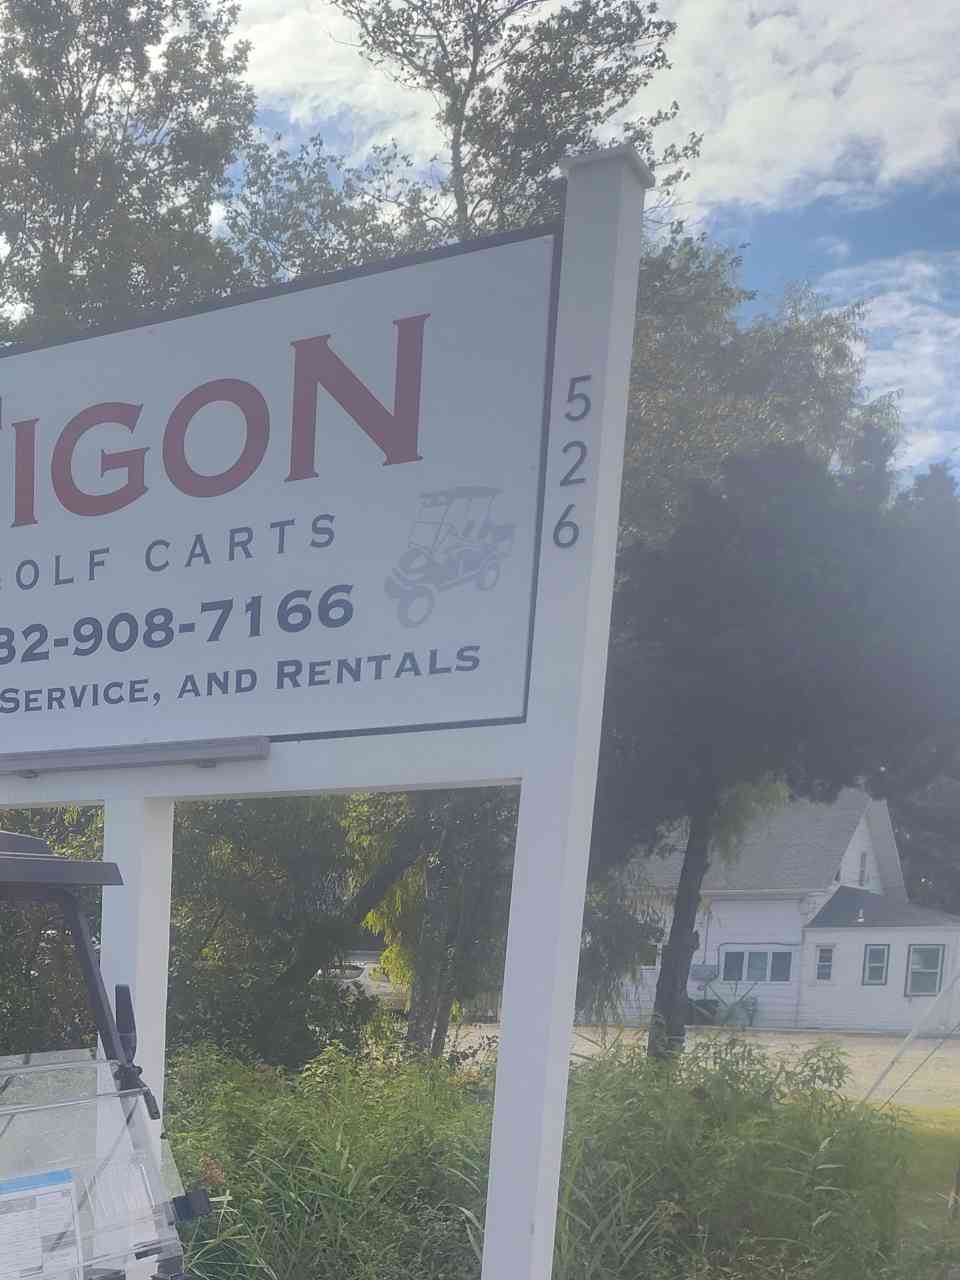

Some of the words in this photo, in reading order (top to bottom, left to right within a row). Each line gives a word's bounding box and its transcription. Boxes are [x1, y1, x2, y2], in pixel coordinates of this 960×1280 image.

[144, 514, 338, 573] CARTS
[177, 668, 259, 700] AND
[274, 645, 482, 691] RENTALS
